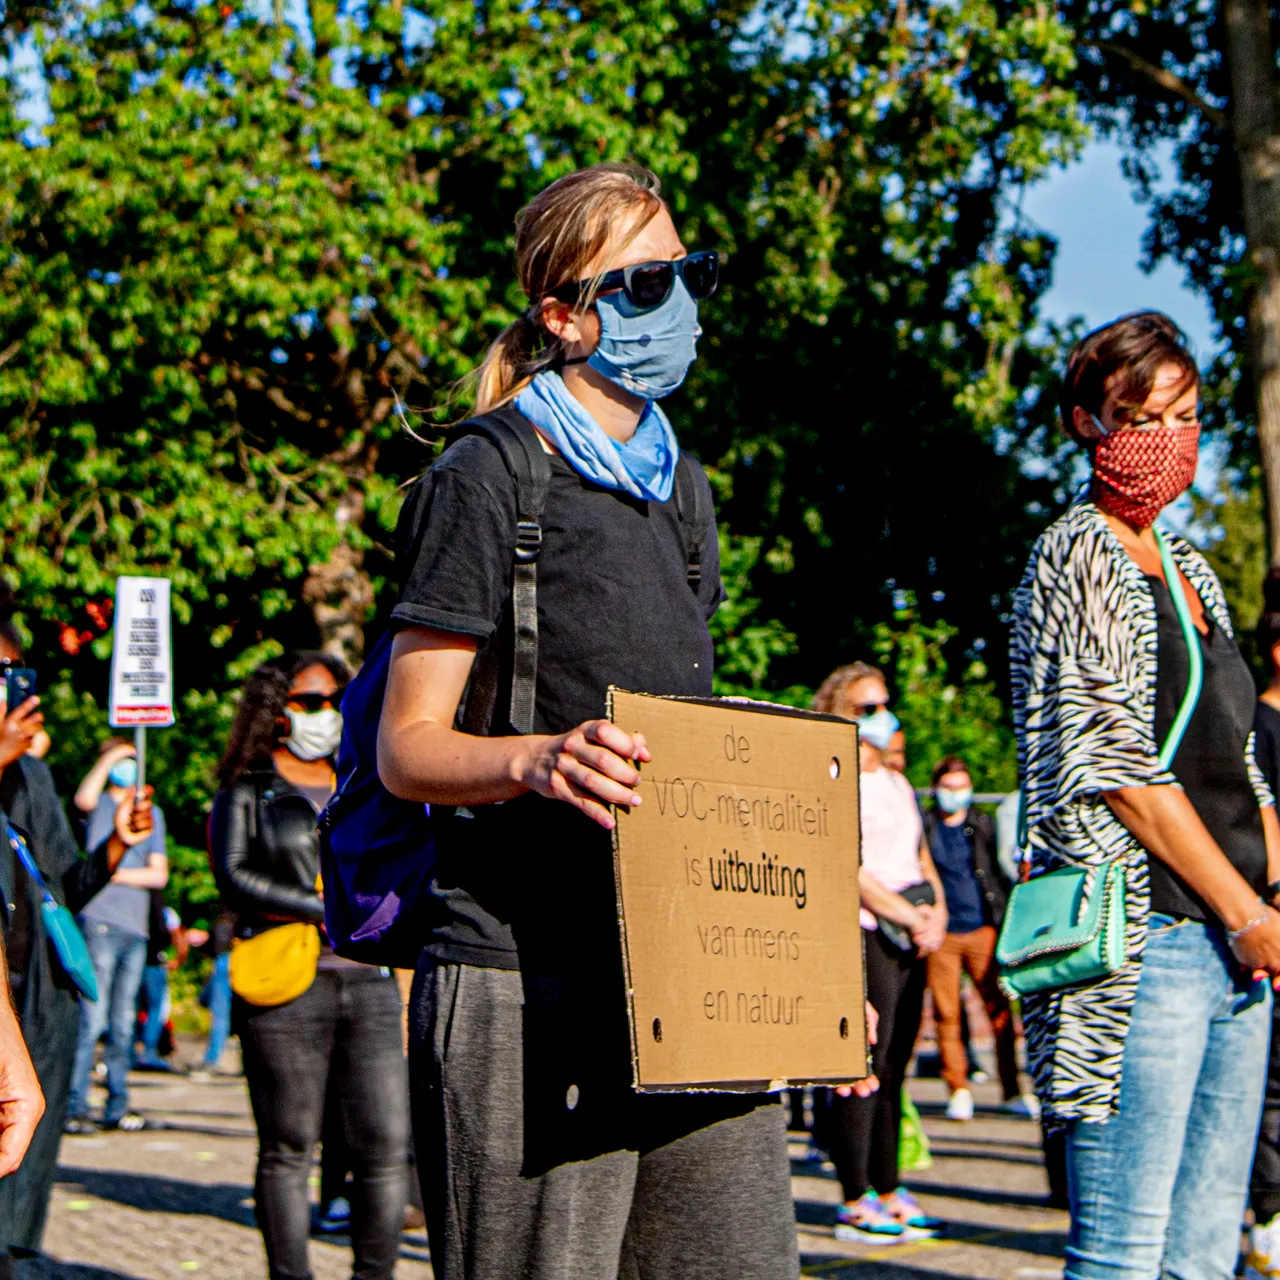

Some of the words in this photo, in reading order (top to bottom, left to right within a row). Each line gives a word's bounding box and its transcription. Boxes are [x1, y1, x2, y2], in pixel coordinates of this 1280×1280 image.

[724, 724, 750, 763] de
[652, 775, 829, 837] VOC-mentaliteit
[684, 845, 702, 886] is
[709, 848, 807, 909] uitbuiting
[697, 924, 737, 958] van
[744, 927, 800, 961] mens
[704, 989, 728, 1022] en
[737, 986, 804, 1025] natuur
